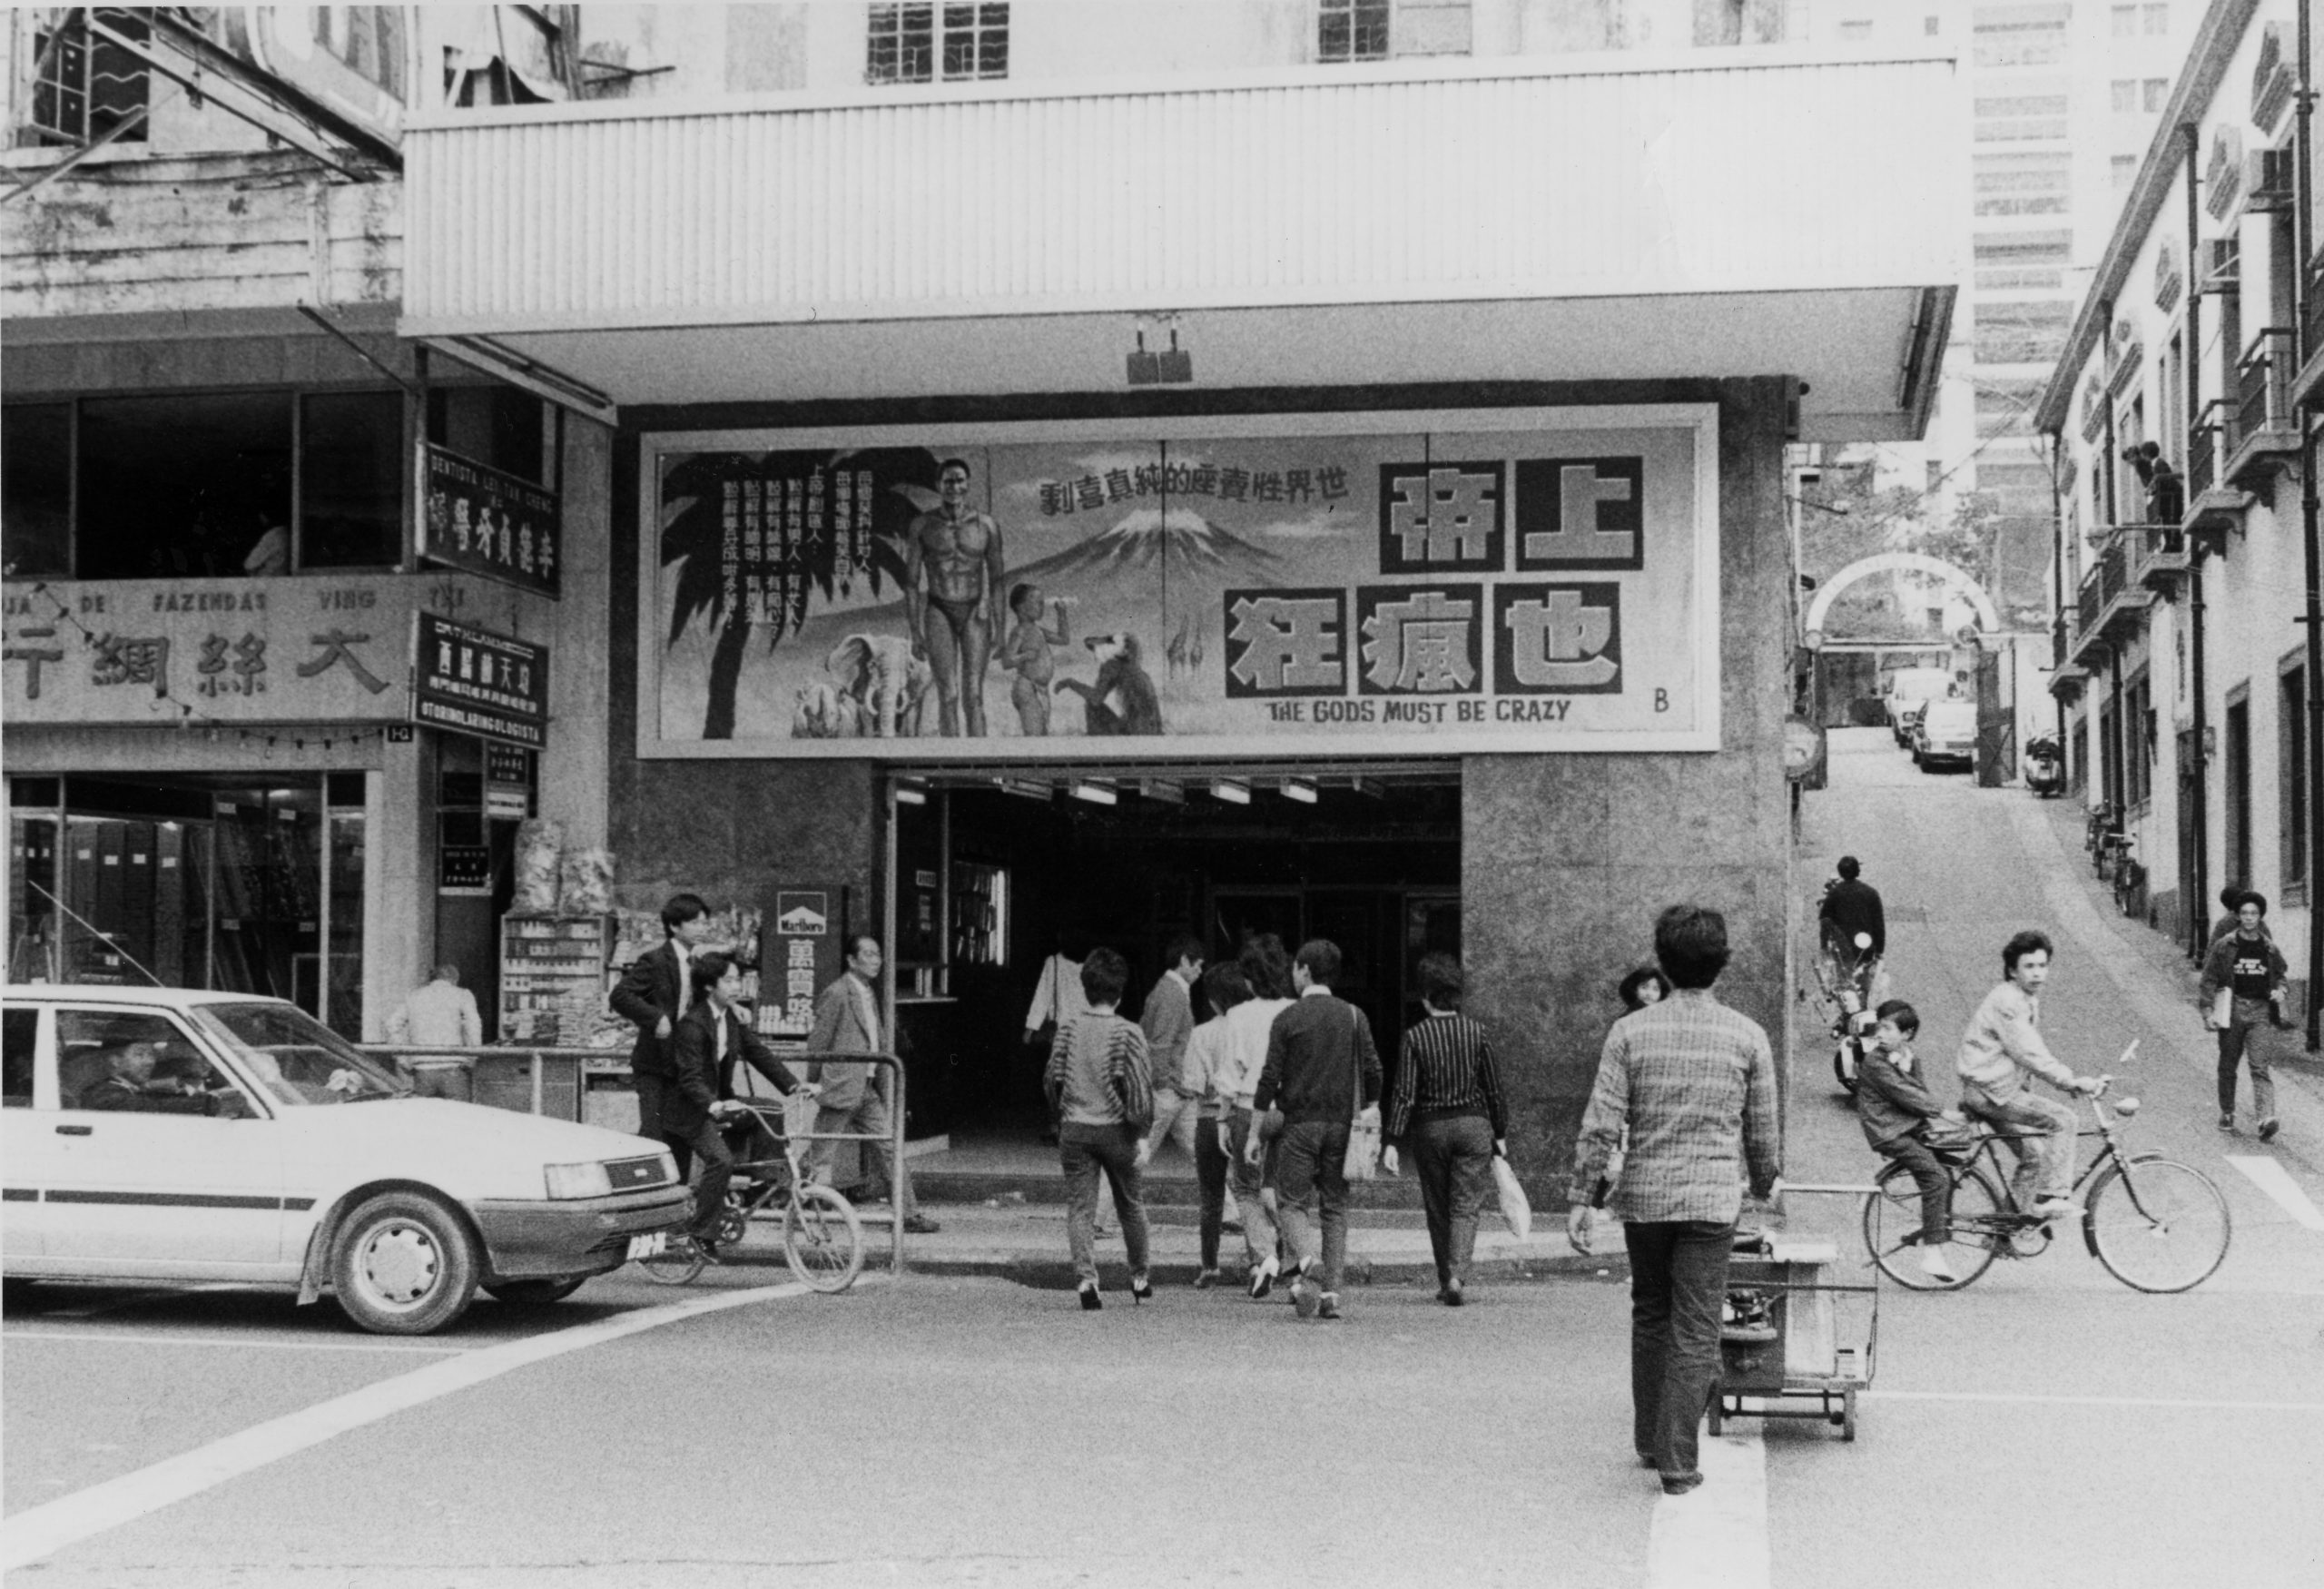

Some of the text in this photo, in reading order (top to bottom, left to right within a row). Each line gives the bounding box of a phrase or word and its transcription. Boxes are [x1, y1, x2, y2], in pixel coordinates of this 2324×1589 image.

[81, 593, 105, 613] DE
[153, 592, 267, 613] FAZENDAS
[320, 590, 376, 610] VING
[1265, 699, 1571, 723] THE GODS MUST BE CRAZY
[1655, 688, 1669, 713] B
[781, 918, 823, 933] Marlboro
